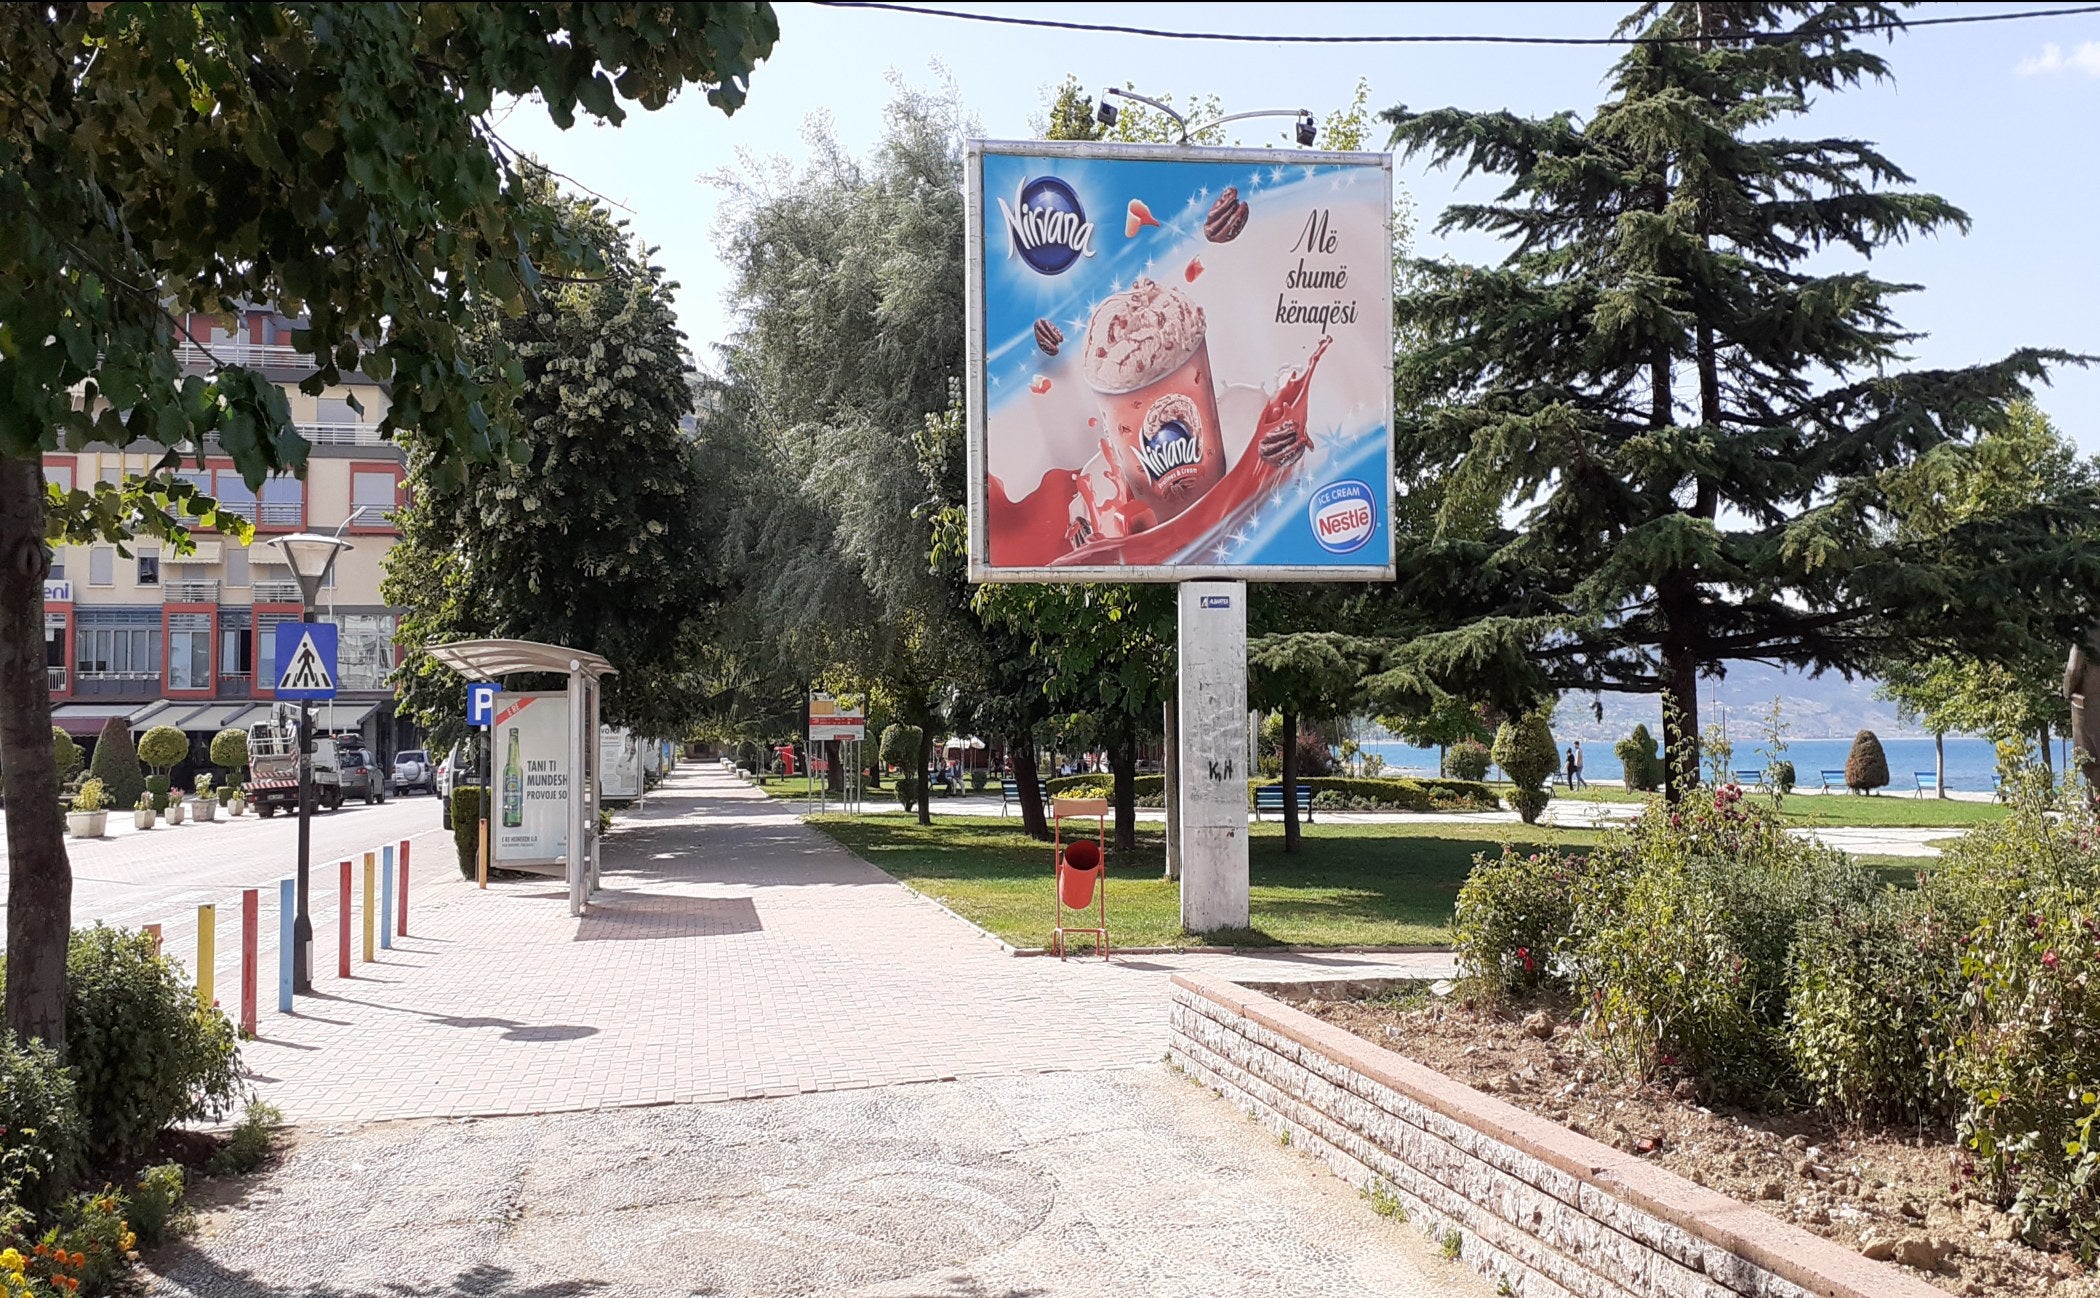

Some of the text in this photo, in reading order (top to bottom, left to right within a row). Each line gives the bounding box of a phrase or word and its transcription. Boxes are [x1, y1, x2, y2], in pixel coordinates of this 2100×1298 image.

[997, 176, 1096, 260] Nirvana
[1290, 209, 1339, 254] Më
[1286, 258, 1348, 289] shumë
[1275, 293, 1358, 334] kënaqësi
[1129, 427, 1203, 486] Nirvana
[1318, 487, 1360, 505] ICE CREAM
[475, 688, 493, 720] P
[527, 760, 557, 772] TANI TI
[527, 774, 568, 786] MUNDESH
[526, 790, 556, 800] PROVOJE
[558, 790, 568, 800] SO
